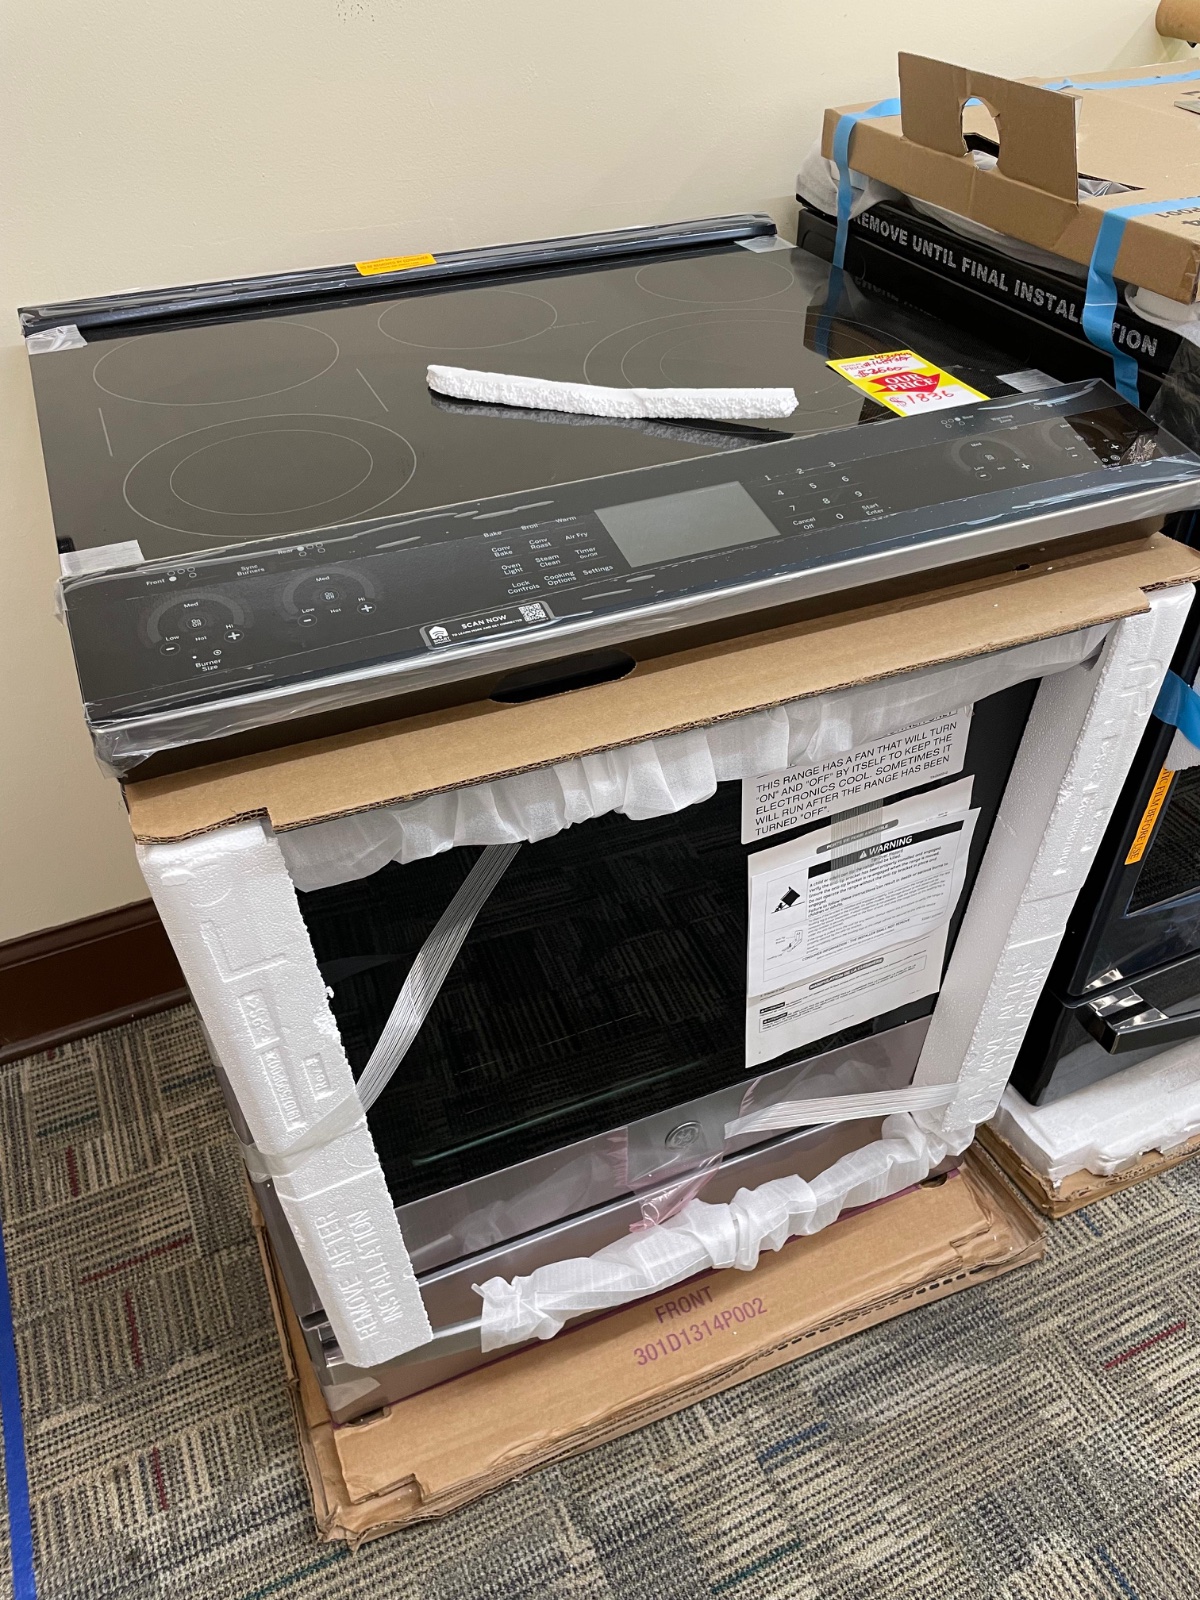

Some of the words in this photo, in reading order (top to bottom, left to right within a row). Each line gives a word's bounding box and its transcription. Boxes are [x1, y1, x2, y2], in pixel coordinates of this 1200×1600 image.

[912, 235, 957, 269] UNTIL
[961, 256, 1008, 291] FINAL
[1014, 279, 1158, 357] INSTALTION
[884, 373, 921, 385] OUR
[886, 378, 937, 392] PRICE
[889, 390, 954, 407] $1836
[861, 502, 880, 510] Start
[555, 515, 577, 523] Warm
[792, 517, 816, 526] Cancel
[520, 523, 539, 531] Broil
[576, 531, 588, 539] Fry
[528, 537, 548, 545] Conv
[530, 541, 552, 550] Roast
[491, 545, 511, 553] Conv
[494, 550, 513, 558] Bake
[574, 546, 596, 555] Timer
[535, 554, 560, 563] Steam
[539, 559, 561, 568] Clean
[240, 564, 258, 572] Sync
[501, 562, 521, 570] Oven
[503, 566, 523, 576] Light
[582, 565, 614, 576] Settings
[237, 567, 265, 577] Burners
[543, 570, 575, 581] Cooking
[146, 578, 165, 586] Front
[511, 580, 530, 588] Lock
[547, 575, 577, 586] Options
[507, 584, 540, 595] Controls
[461, 618, 485, 630] SCAN
[485, 614, 507, 625] NOW
[195, 658, 222, 668] Burner
[202, 664, 219, 672] Size
[757, 779, 780, 793] THIS
[783, 766, 820, 785] RANGE
[822, 758, 844, 772] HAS
[845, 756, 853, 765] A
[854, 748, 875, 761] FAN
[877, 739, 902, 754] THAT
[904, 732, 927, 745] WILL
[929, 721, 957, 737] TURN
[756, 790, 779, 803] "ON"
[781, 782, 803, 796] AND
[806, 773, 834, 787] "OFF"
[836, 767, 850, 778] BY
[852, 755, 886, 773] ITSELF
[889, 750, 902, 760] TO
[904, 740, 931, 755] KEEP
[933, 733, 953, 746] THE
[756, 782, 836, 815] ELECTRONICS
[838, 772, 872, 788] COOL.
[875, 748, 940, 776] SOMETIMES
[942, 744, 953, 753] IT
[755, 813, 779, 825] WILL
[782, 804, 804, 817] RUN
[805, 792, 839, 809] AFTER
[842, 784, 861, 797] THE
[864, 772, 899, 790] RANGE
[901, 764, 921, 777] HAS
[923, 755, 950, 770] BEEN
[1151, 786, 1165, 807] FILM
[755, 816, 797, 836] TURNED
[801, 806, 830, 820] "OFF".
[1137, 809, 1156, 842] BEFORE
[869, 836, 912, 855] WARNING
[1130, 842, 1143, 860] USE
[315, 1211, 355, 1269] AFTER
[347, 1209, 404, 1324] INSTALLATION
[338, 1274, 380, 1341] REMOVE
[655, 1285, 714, 1324] FRONT
[634, 1297, 768, 1366] 301D1314P002
